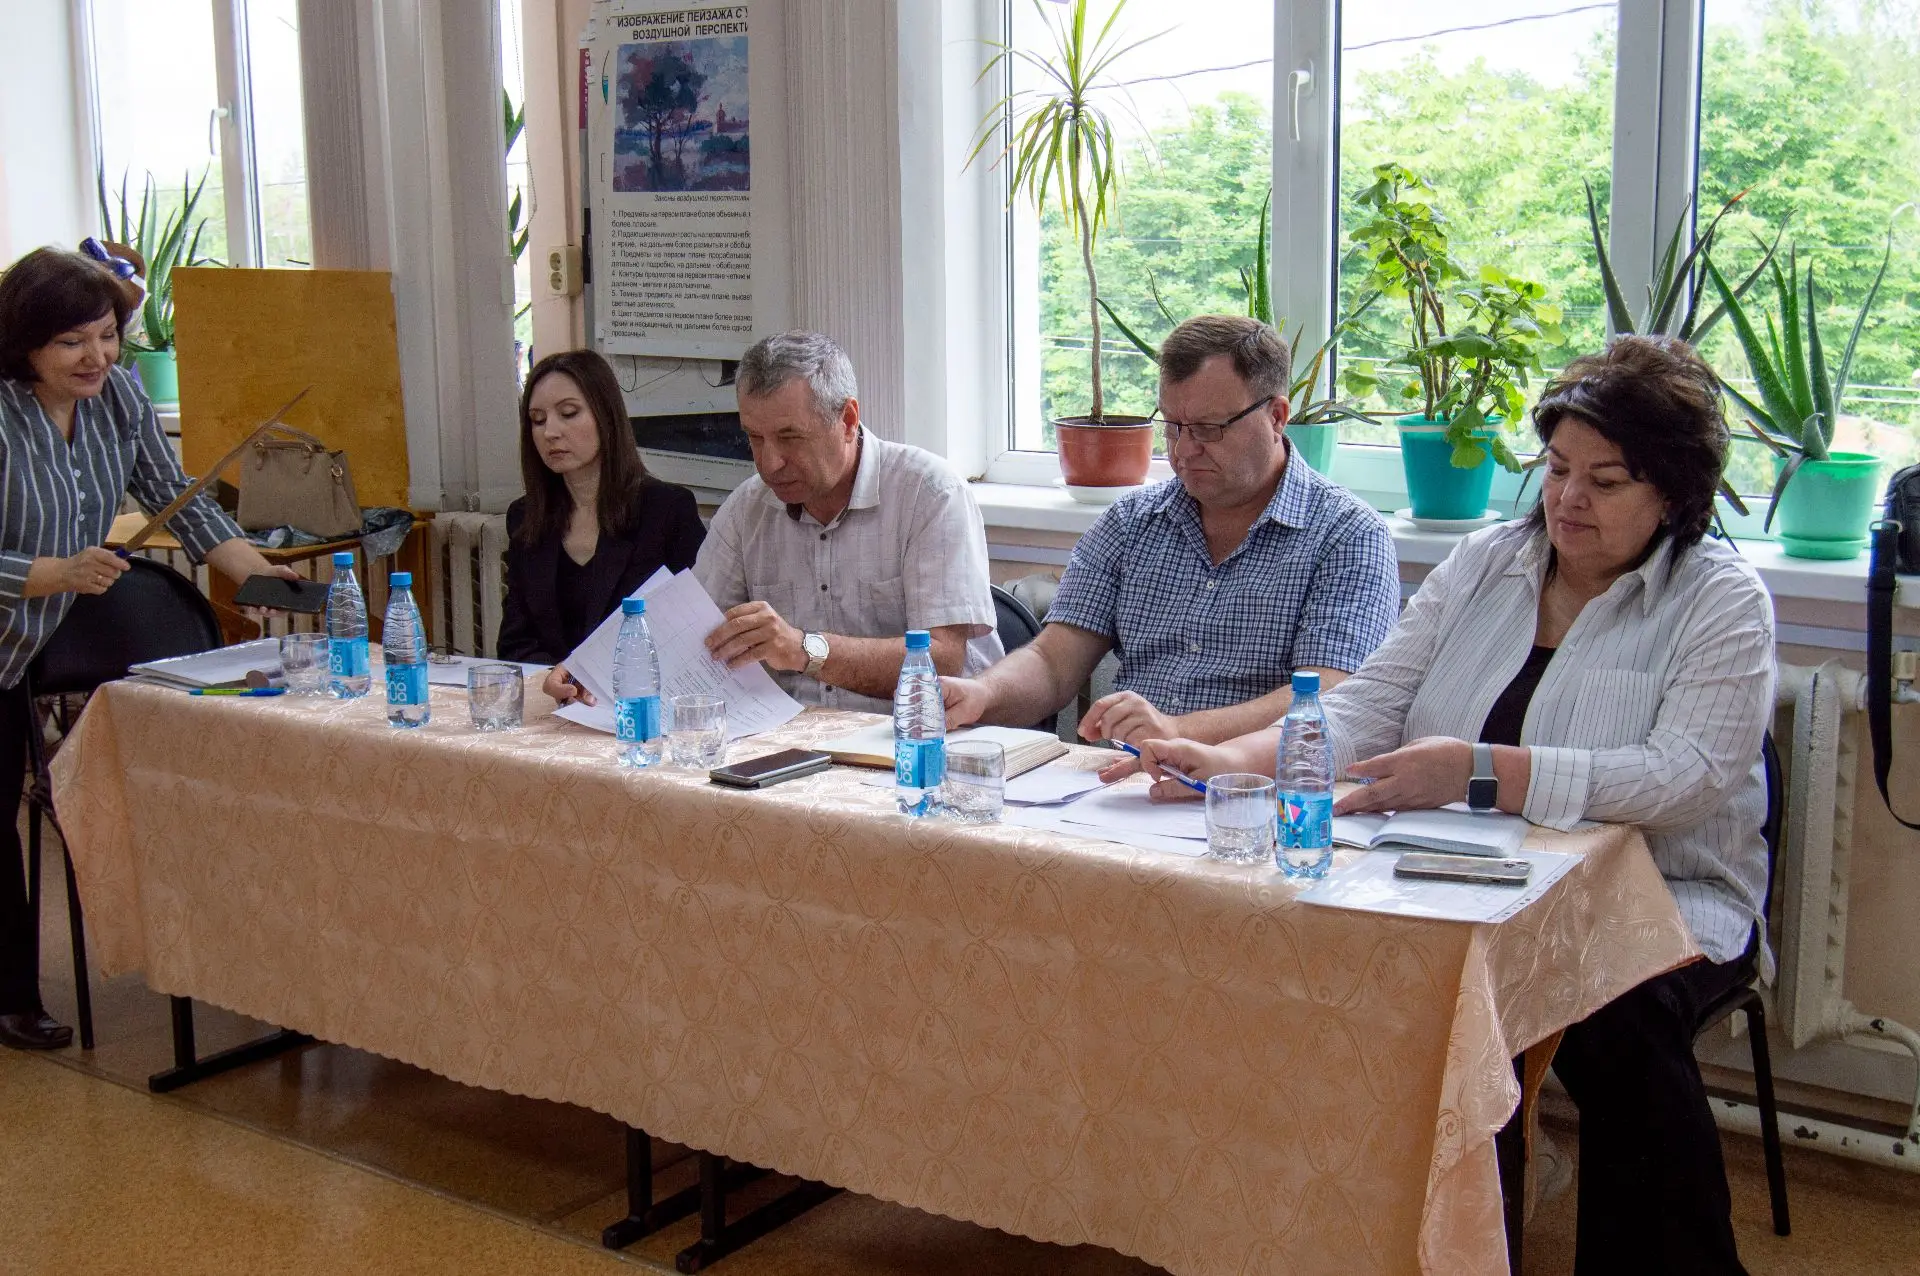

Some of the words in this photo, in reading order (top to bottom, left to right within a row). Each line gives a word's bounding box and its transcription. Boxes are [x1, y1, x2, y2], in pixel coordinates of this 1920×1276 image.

[617, 13, 685, 27] ИЗОБРАЖЕНИЕ
[687, 9, 733, 22] ПЕЙЗАЖА
[736, 8, 742, 18] С
[633, 25, 690, 40] ВОЗДУШНОЙ
